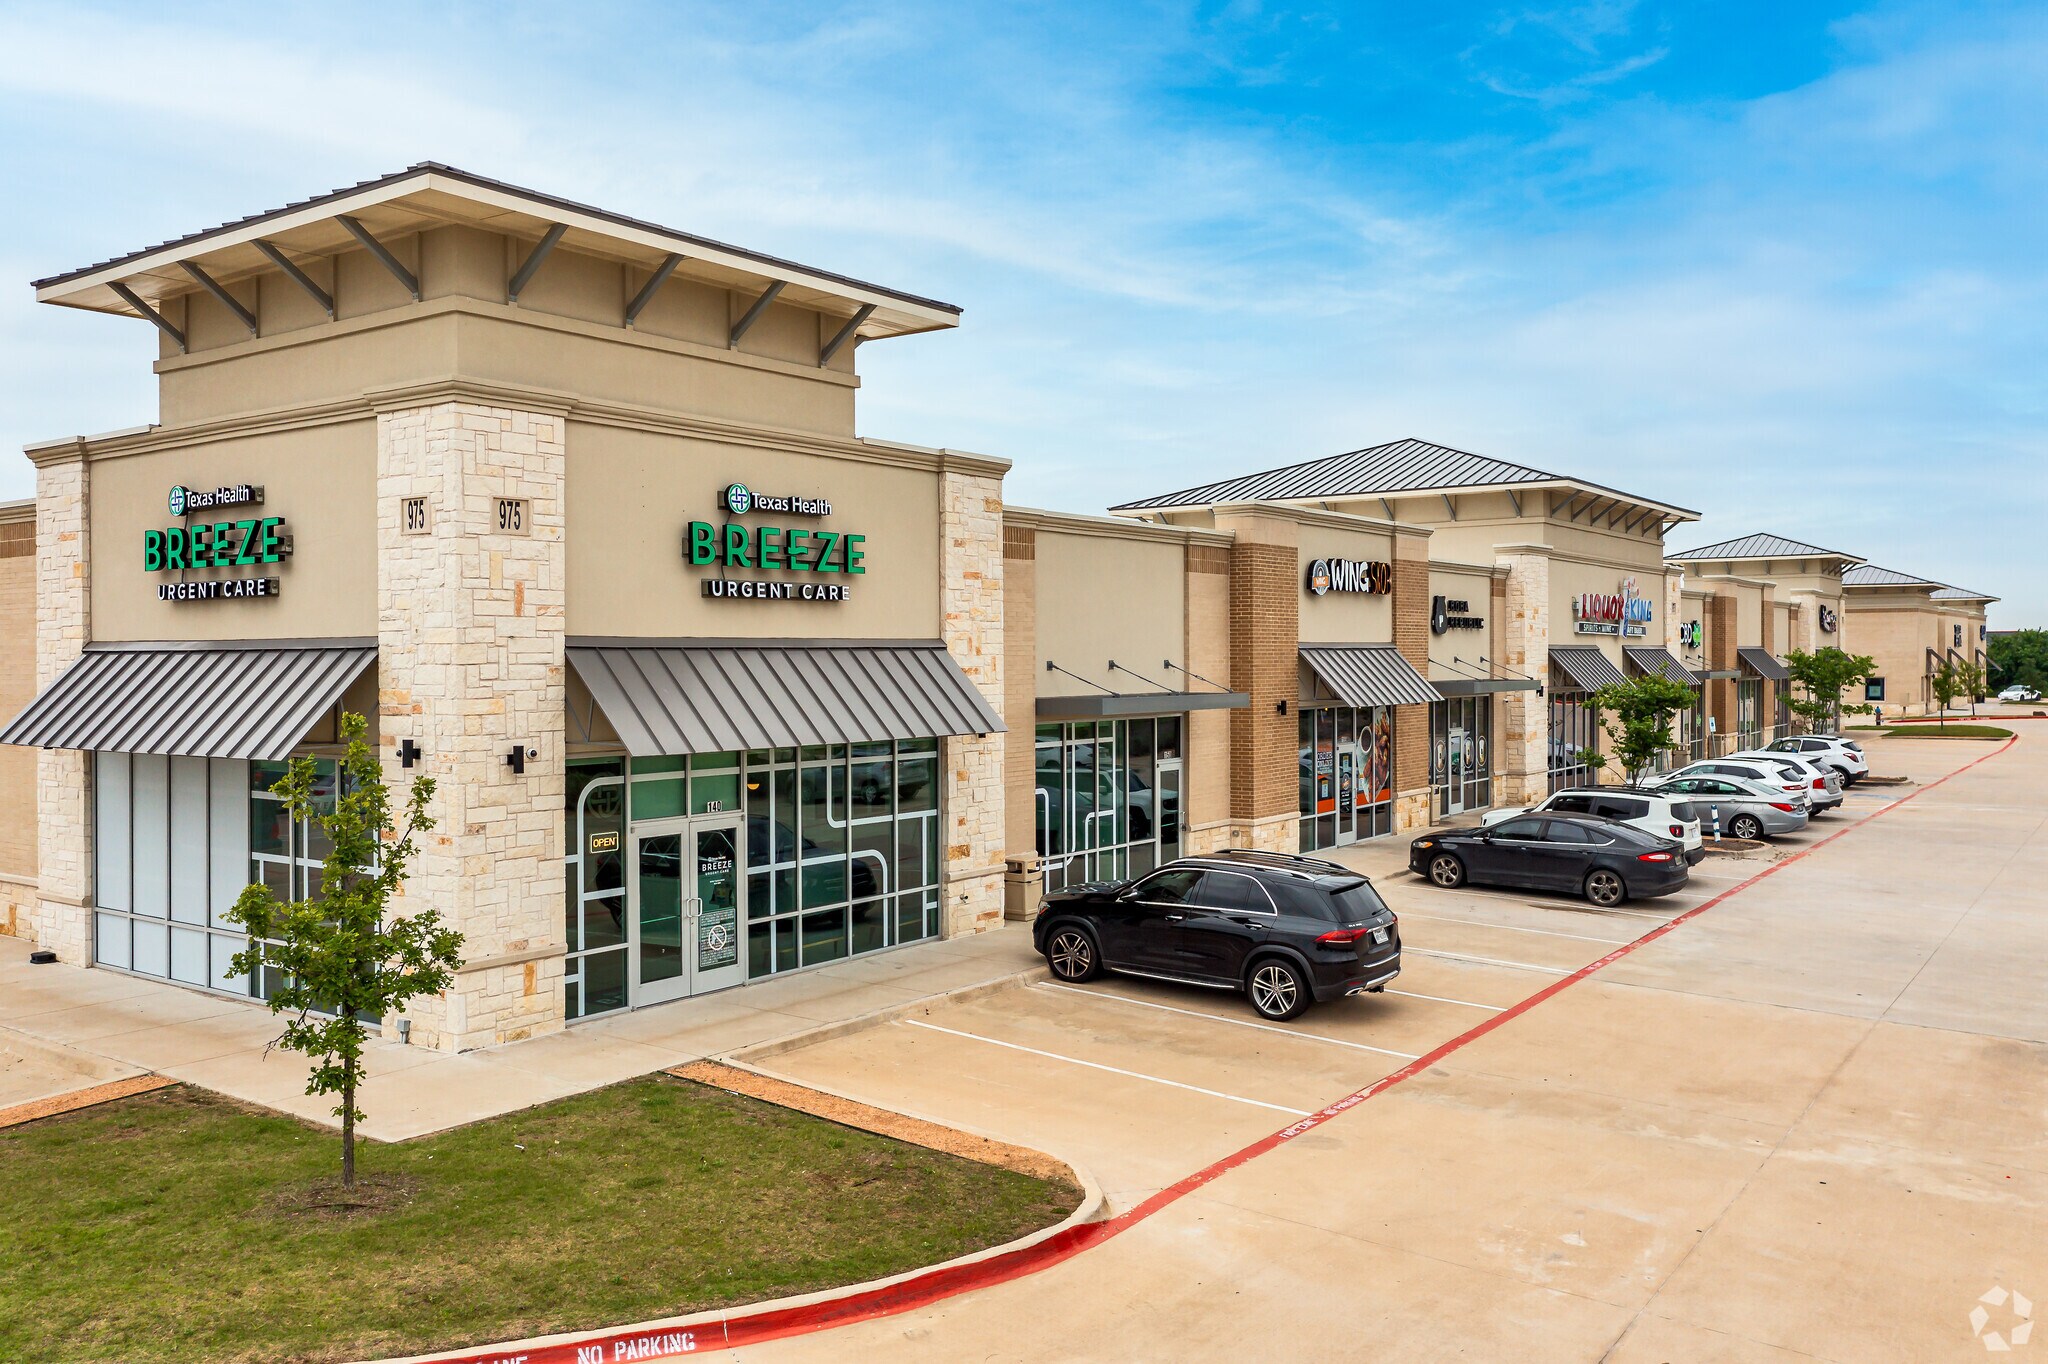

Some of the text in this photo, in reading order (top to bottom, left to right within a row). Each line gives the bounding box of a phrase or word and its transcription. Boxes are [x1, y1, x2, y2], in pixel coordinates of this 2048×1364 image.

[186, 485, 249, 507] Texas Health
[751, 493, 832, 515] Texas Health
[408, 500, 424, 530] 975
[499, 500, 521, 530] 975
[145, 517, 280, 572] BREEZE
[689, 521, 866, 574] BREEZE
[1331, 559, 1369, 592] WING
[157, 578, 265, 600] URGENT CARE
[711, 580, 850, 601] URGENT CARE
[1582, 593, 1625, 622] LIQUOR
[1630, 598, 1652, 622] KING
[707, 800, 722, 812] 140
[592, 837, 615, 848] OPEN
[701, 860, 732, 872] BREEZE
[577, 1333, 695, 1364] NO PARKING
